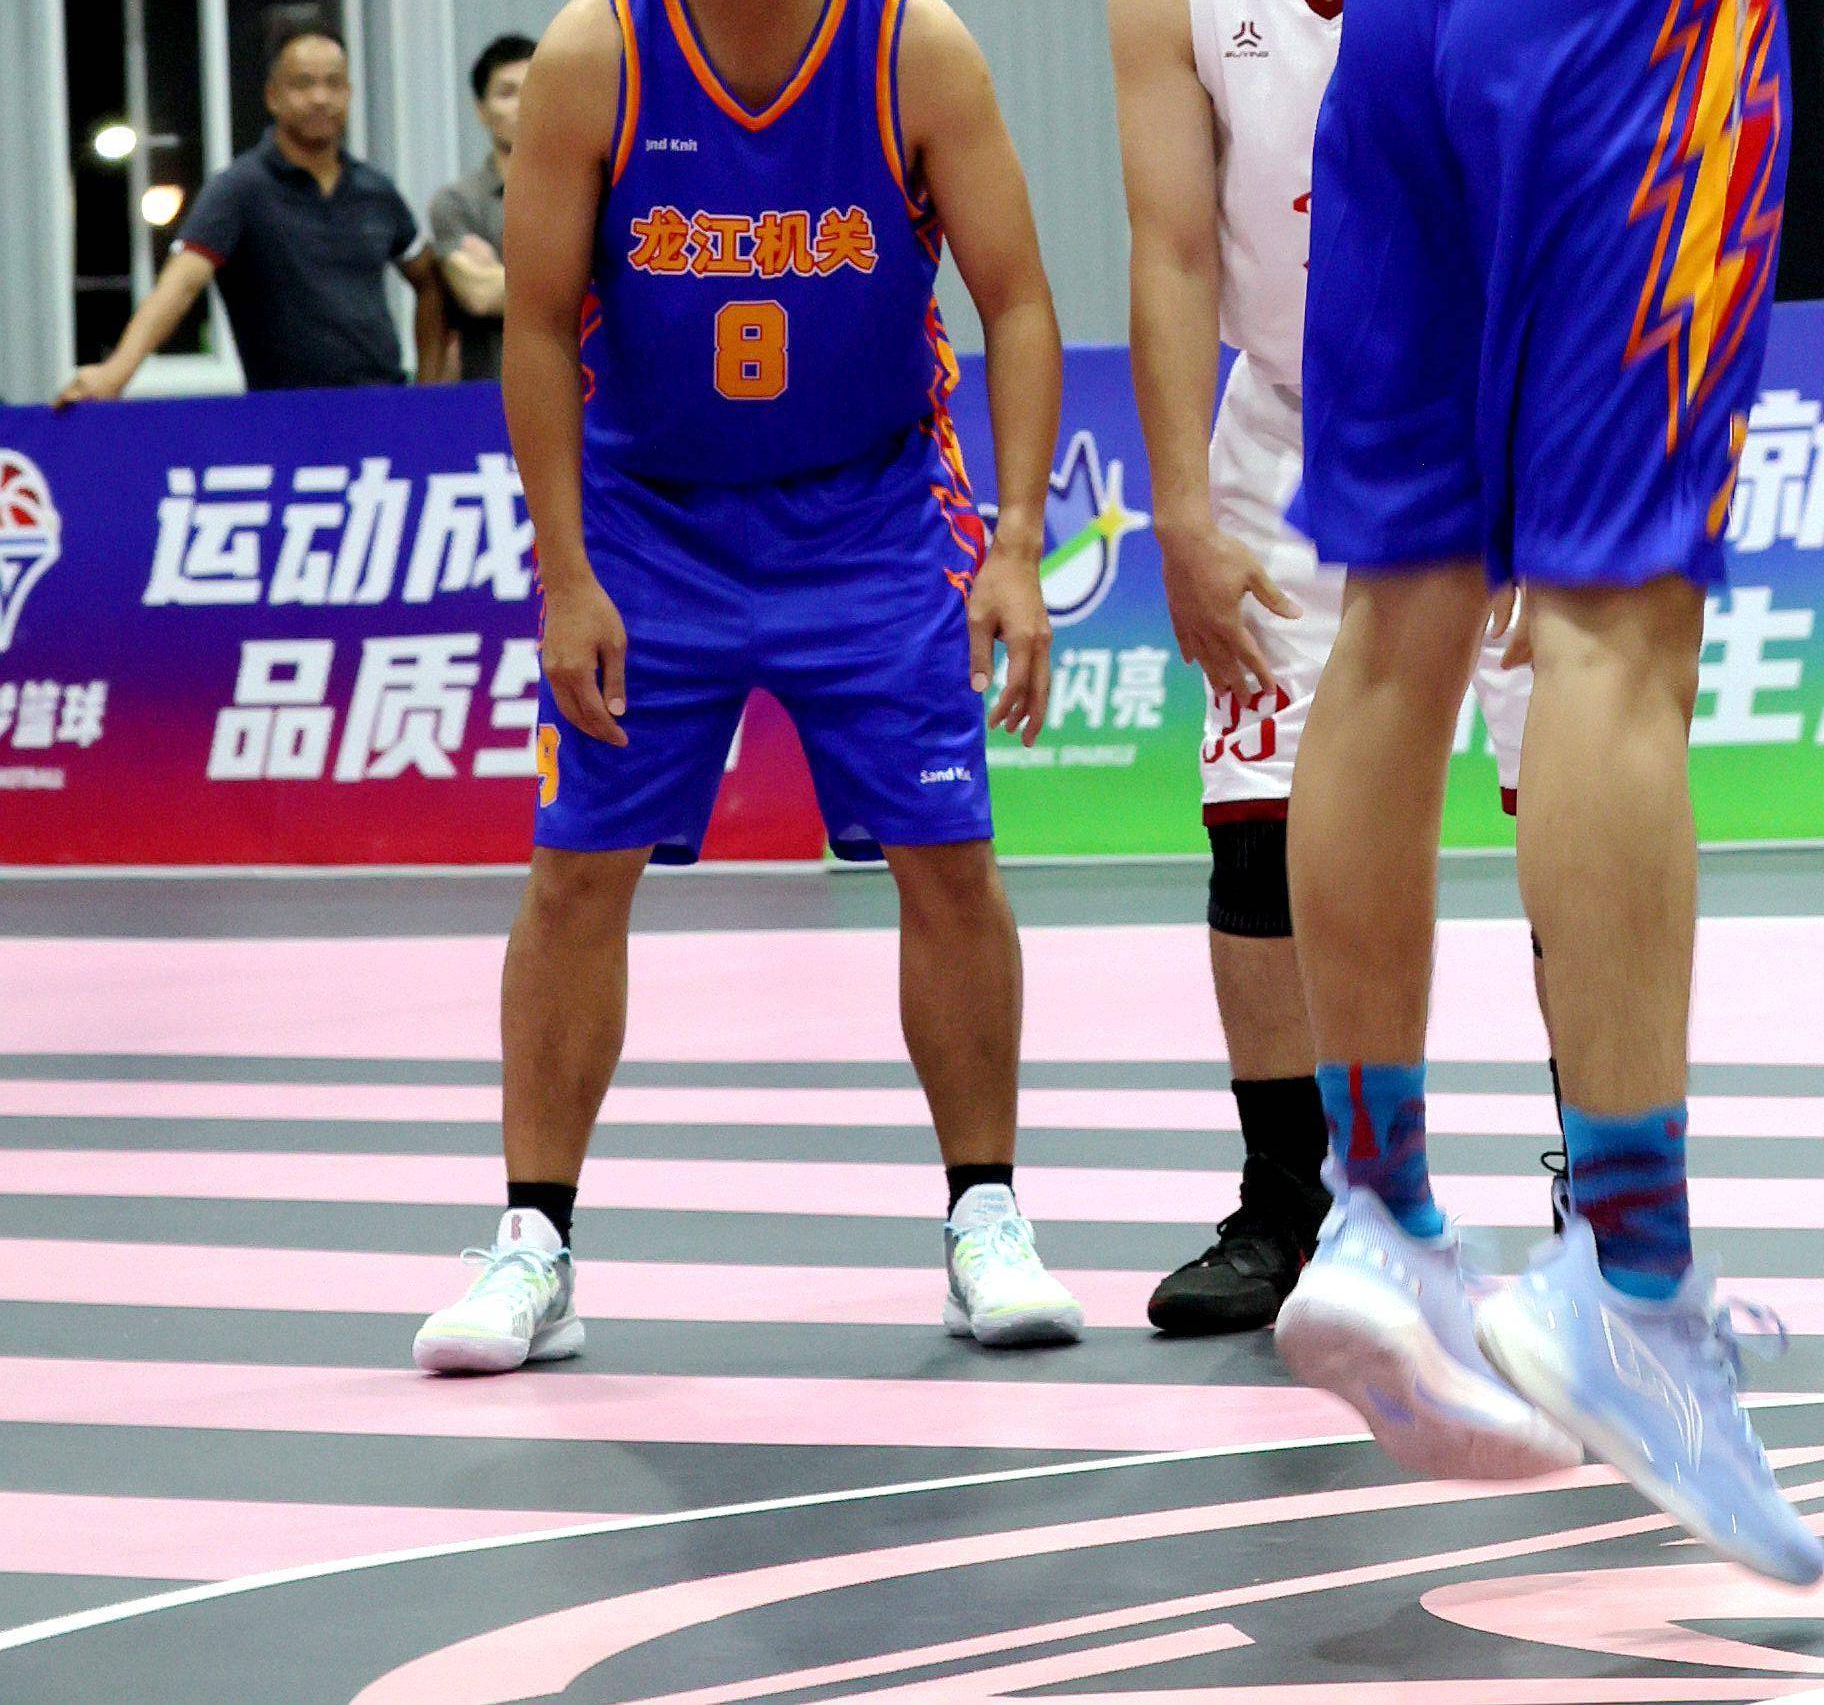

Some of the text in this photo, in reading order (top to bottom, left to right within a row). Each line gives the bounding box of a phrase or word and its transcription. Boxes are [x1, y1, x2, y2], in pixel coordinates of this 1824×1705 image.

[628, 205, 879, 278] 龙江机关
[714, 300, 788, 400] 8
[142, 453, 537, 607] 运动成
[0, 680, 108, 750] 篮球
